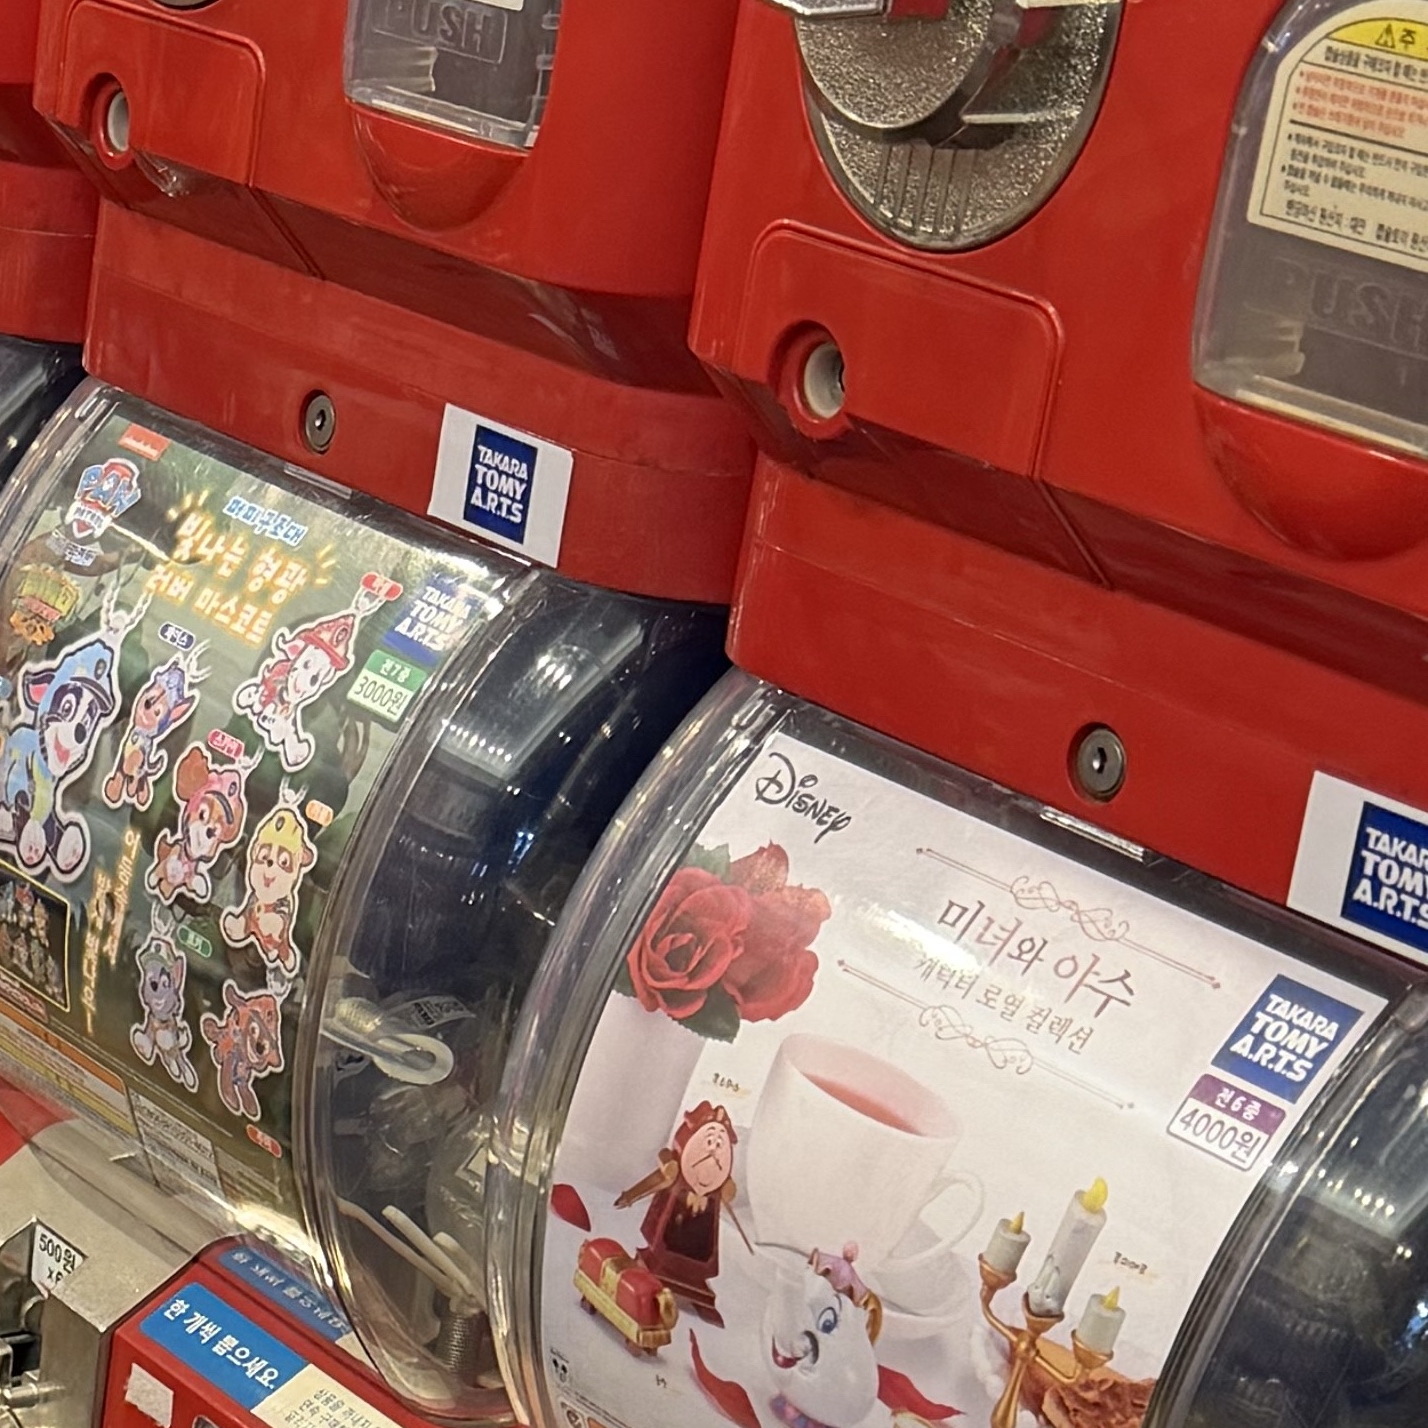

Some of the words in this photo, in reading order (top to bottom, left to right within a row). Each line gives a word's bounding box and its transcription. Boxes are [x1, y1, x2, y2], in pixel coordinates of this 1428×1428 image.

[475, 465, 528, 498] TOMY
[352, 675, 409, 716] 3000원
[1366, 826, 1428, 868] TAKAR
[937, 899, 1049, 977] 미녀와
[1053, 952, 1136, 1020] 야수
[976, 986, 1029, 1021] 로열
[1025, 1007, 1096, 1056] 컬렉션
[1253, 1011, 1328, 1060] TOMY
[1269, 993, 1340, 1042] TAKARA
[1179, 1108, 1263, 1164] 4000원
[38, 1233, 77, 1275] 500원
[163, 1298, 190, 1322] 한
[183, 1310, 222, 1343] 개씩
